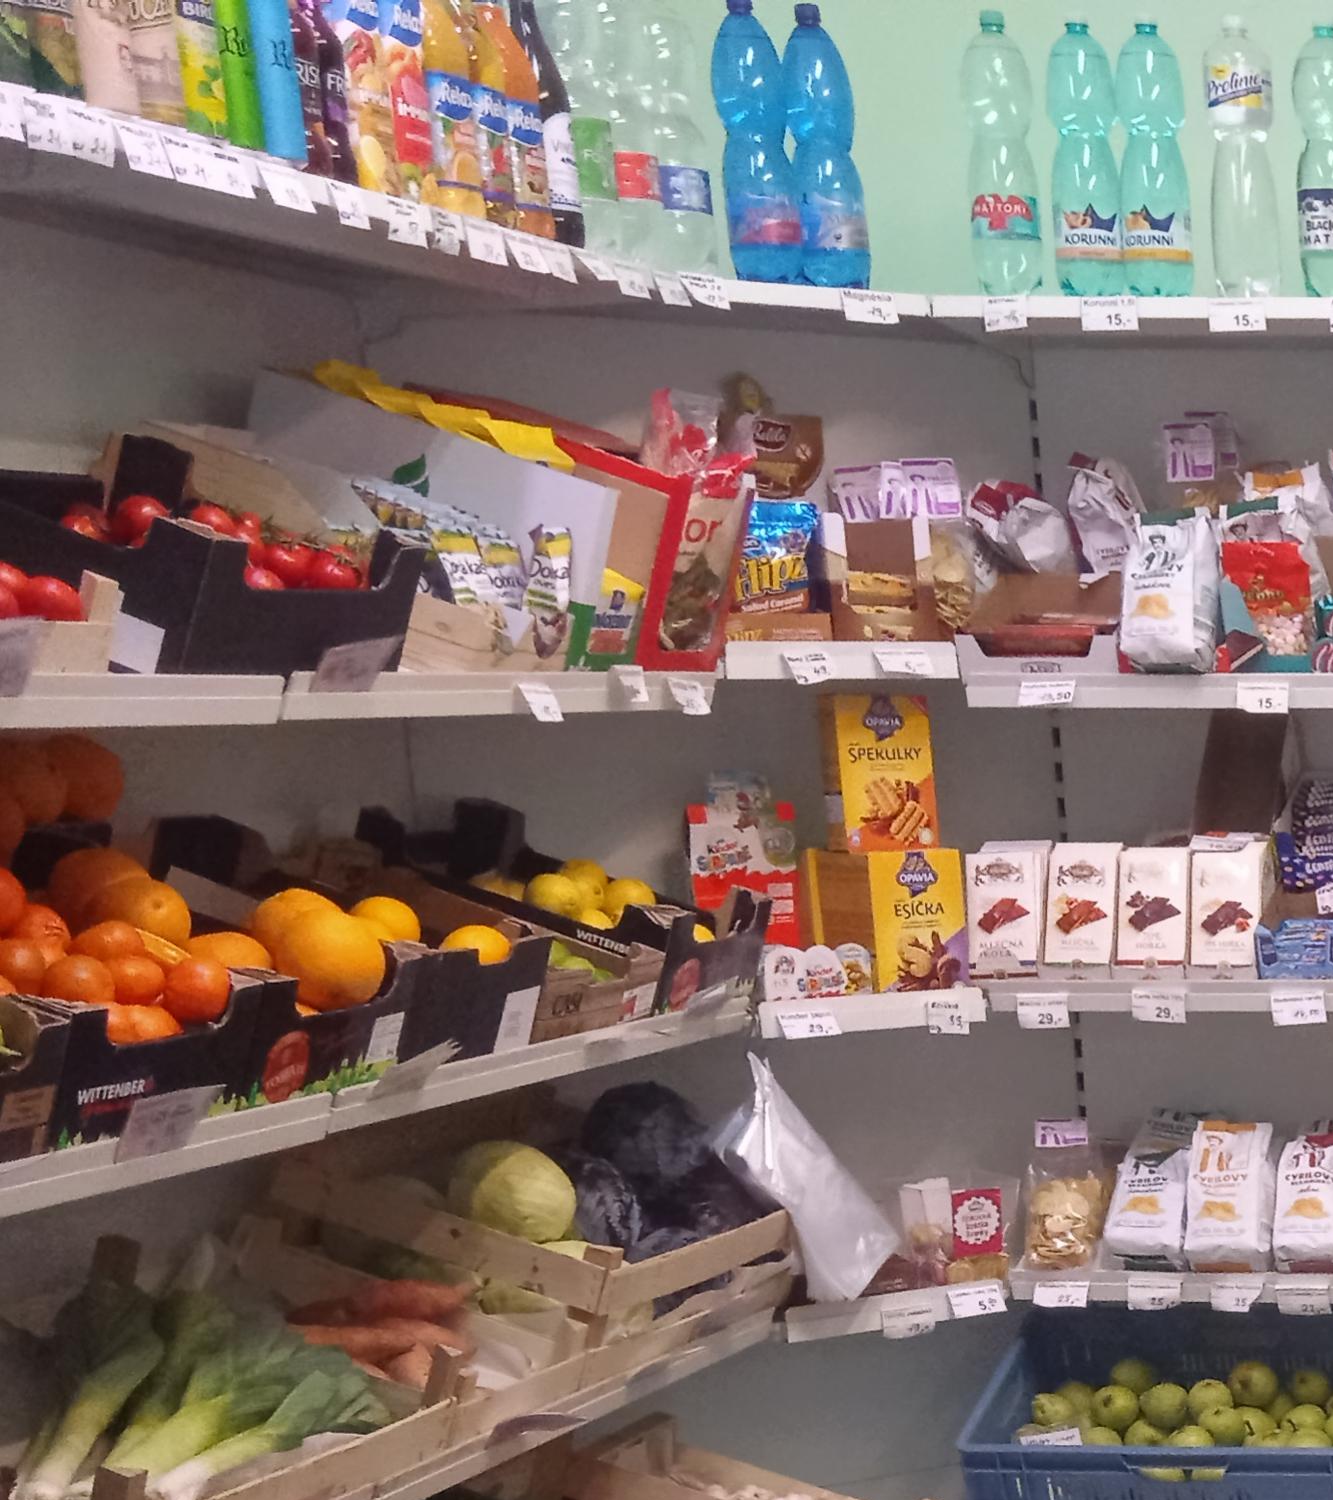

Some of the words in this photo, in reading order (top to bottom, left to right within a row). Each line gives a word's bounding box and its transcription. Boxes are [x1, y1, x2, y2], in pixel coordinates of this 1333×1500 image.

[1106, 314, 1133, 328] 15,-
[1233, 314, 1260, 328] 15,-
[847, 744, 922, 764] ŠPEKULKY
[899, 871, 936, 885] OPAVIA
[894, 899, 945, 918] ESÍČKA
[1037, 1012, 1063, 1025] 29,-
